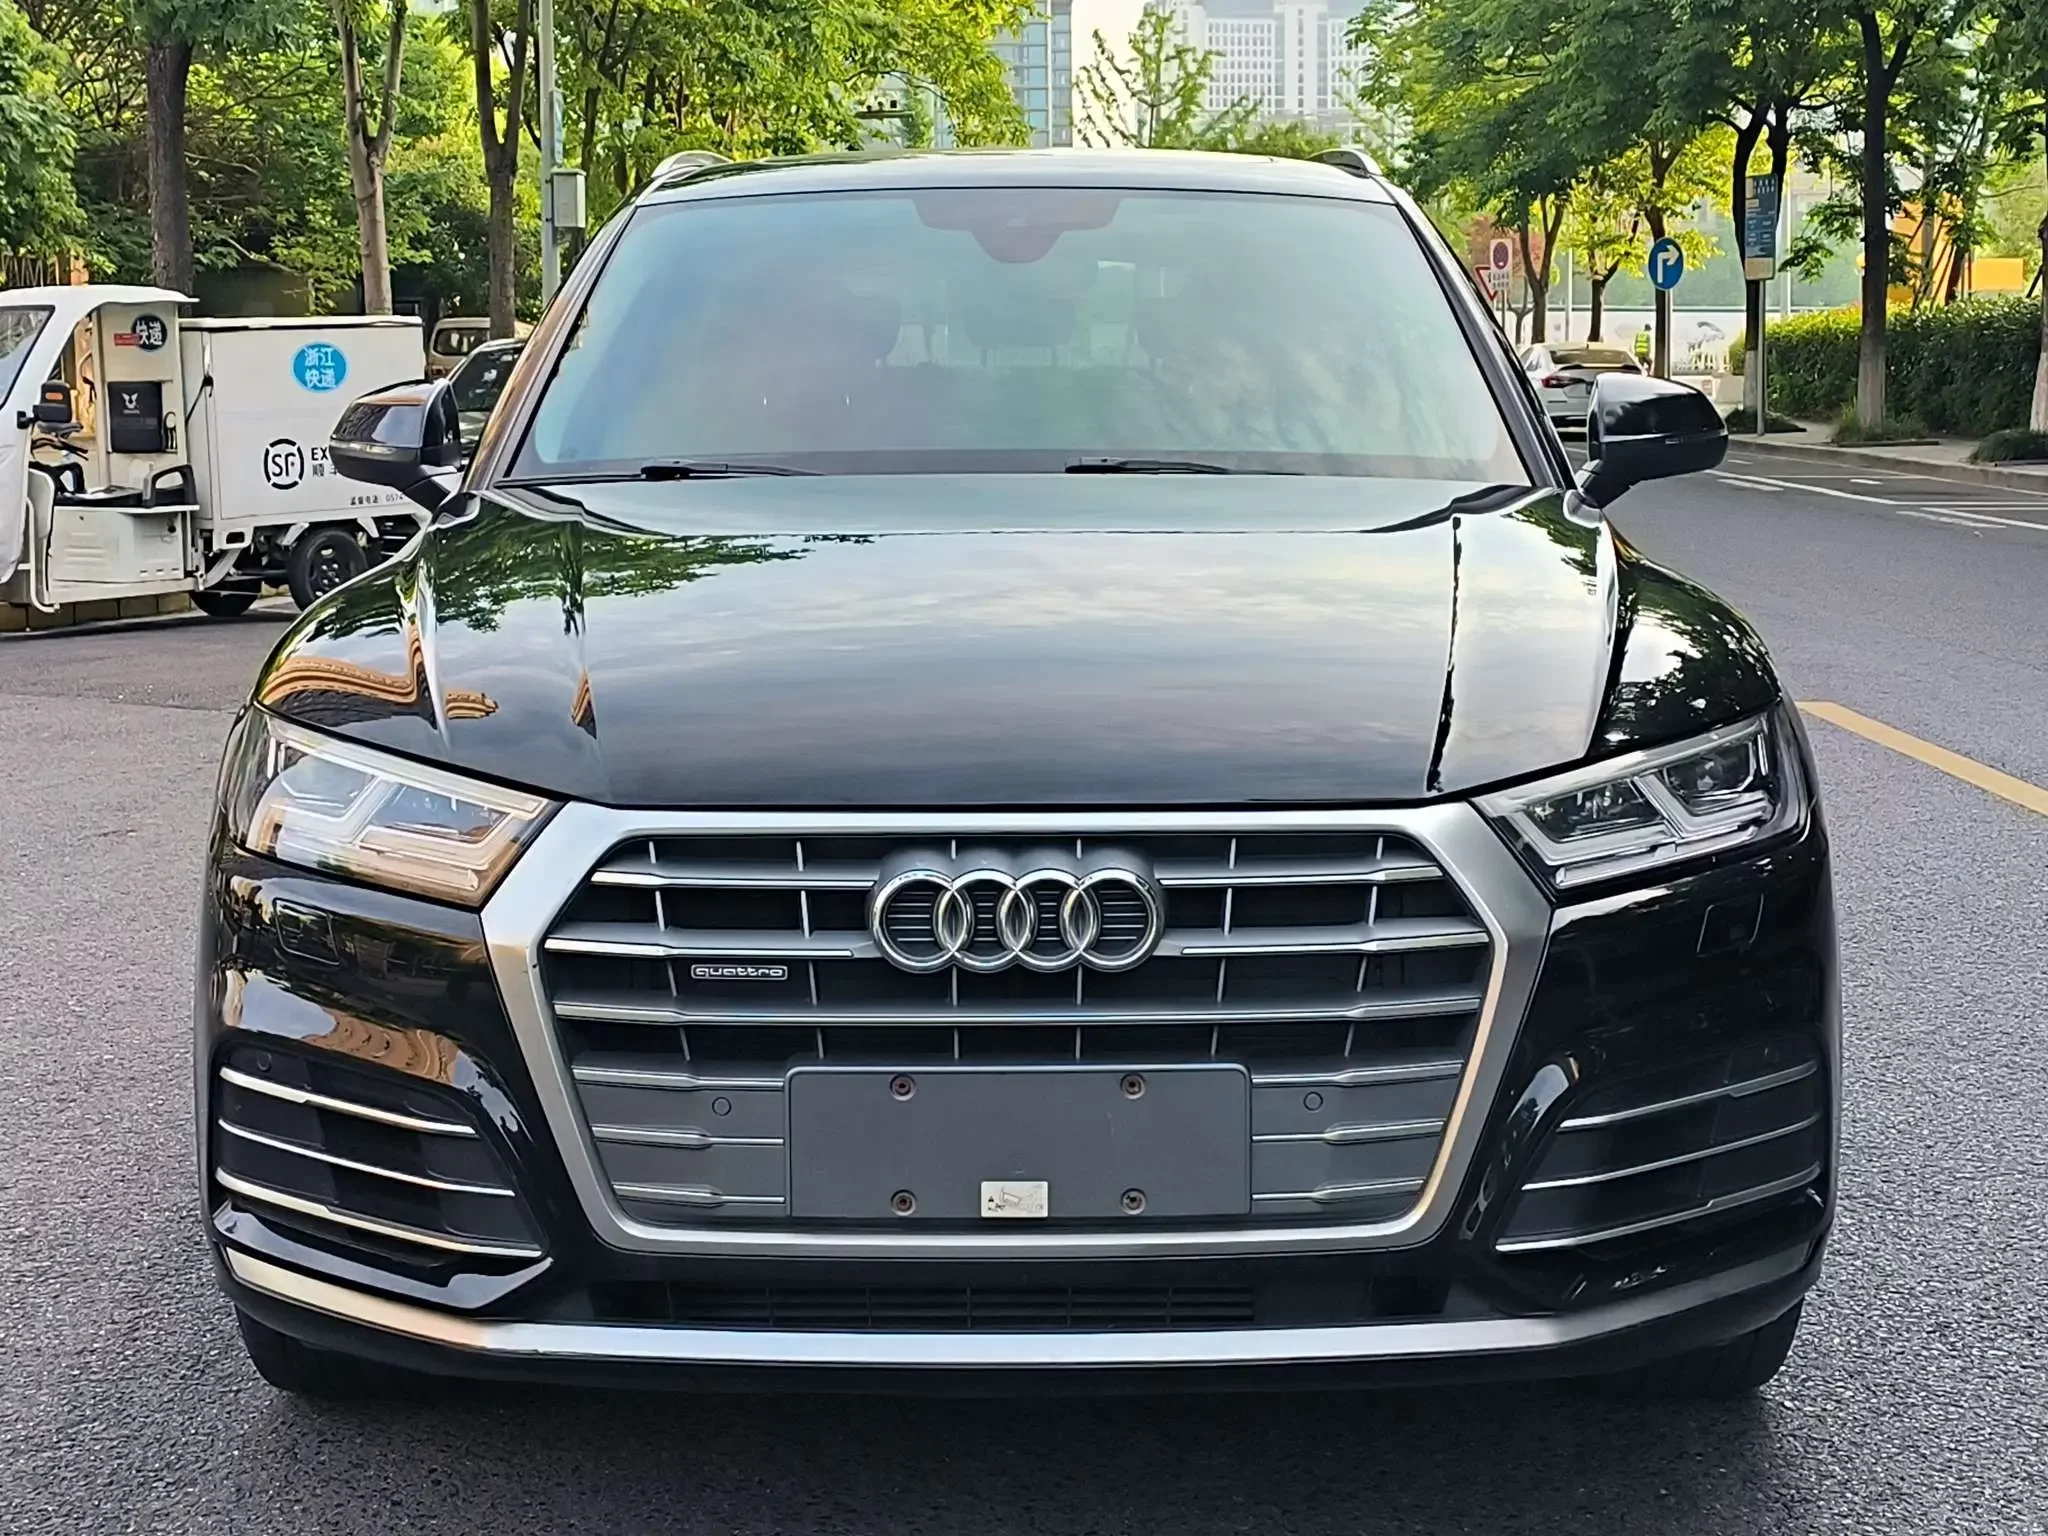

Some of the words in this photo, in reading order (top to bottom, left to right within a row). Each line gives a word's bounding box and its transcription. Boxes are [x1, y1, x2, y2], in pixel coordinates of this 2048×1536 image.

[303, 346, 336, 367] 浙江
[304, 367, 337, 388] 快递
[695, 967, 783, 977] quattro
